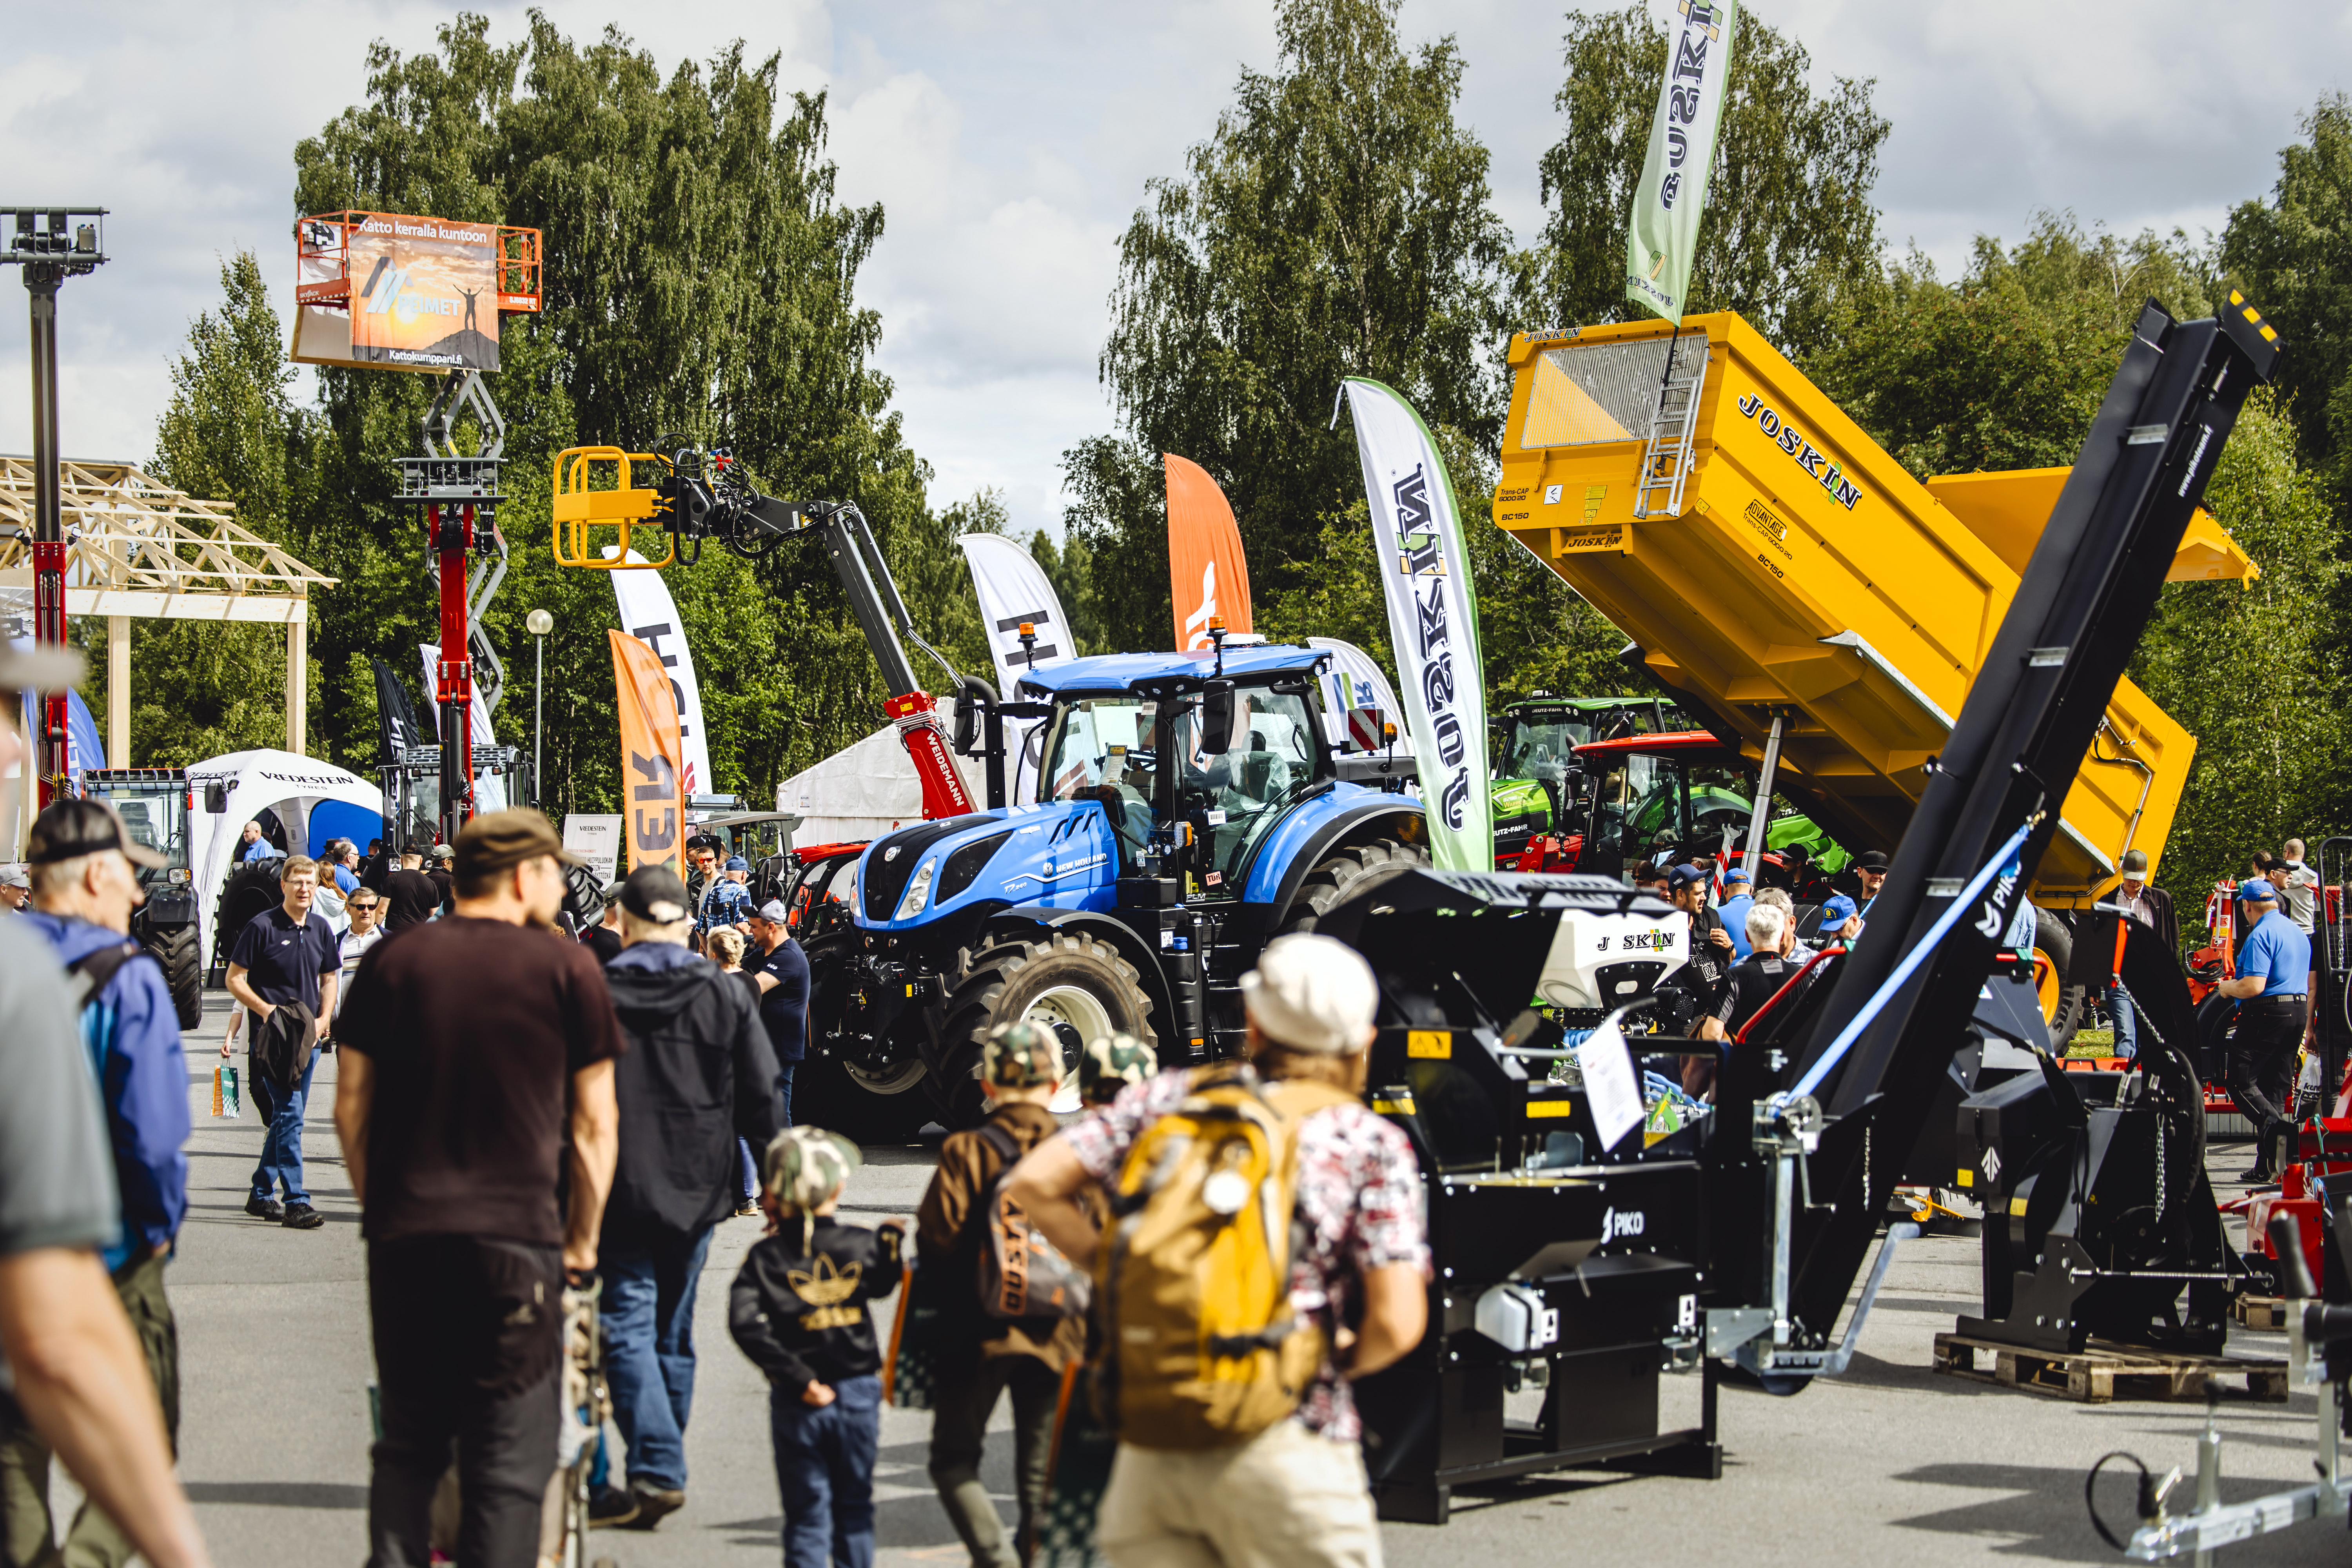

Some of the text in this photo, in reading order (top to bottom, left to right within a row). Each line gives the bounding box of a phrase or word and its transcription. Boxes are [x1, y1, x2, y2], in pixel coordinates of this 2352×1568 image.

[360, 220, 487, 243] Katto kerralla kuntoon
[398, 296, 461, 316] PEIMET
[1524, 327, 1582, 343] JOSKIN
[389, 350, 463, 365] Kattokumppani.fi
[1738, 392, 1862, 511] JOSKIN
[2178, 424, 2214, 497] www.pikoteam.fi
[1743, 512, 1769, 537] Trans-CAP
[1745, 501, 1784, 537] ADVANTAGE
[1568, 536, 1622, 548] JOSKIN
[259, 771, 354, 784] VREDESTEIN
[927, 732, 964, 806] WEIDEMANN
[1494, 824, 1528, 836] EUTZ-FAHR
[1056, 853, 1107, 875] NEW HOLLAND
[1614, 1211, 1644, 1236] PIKO
